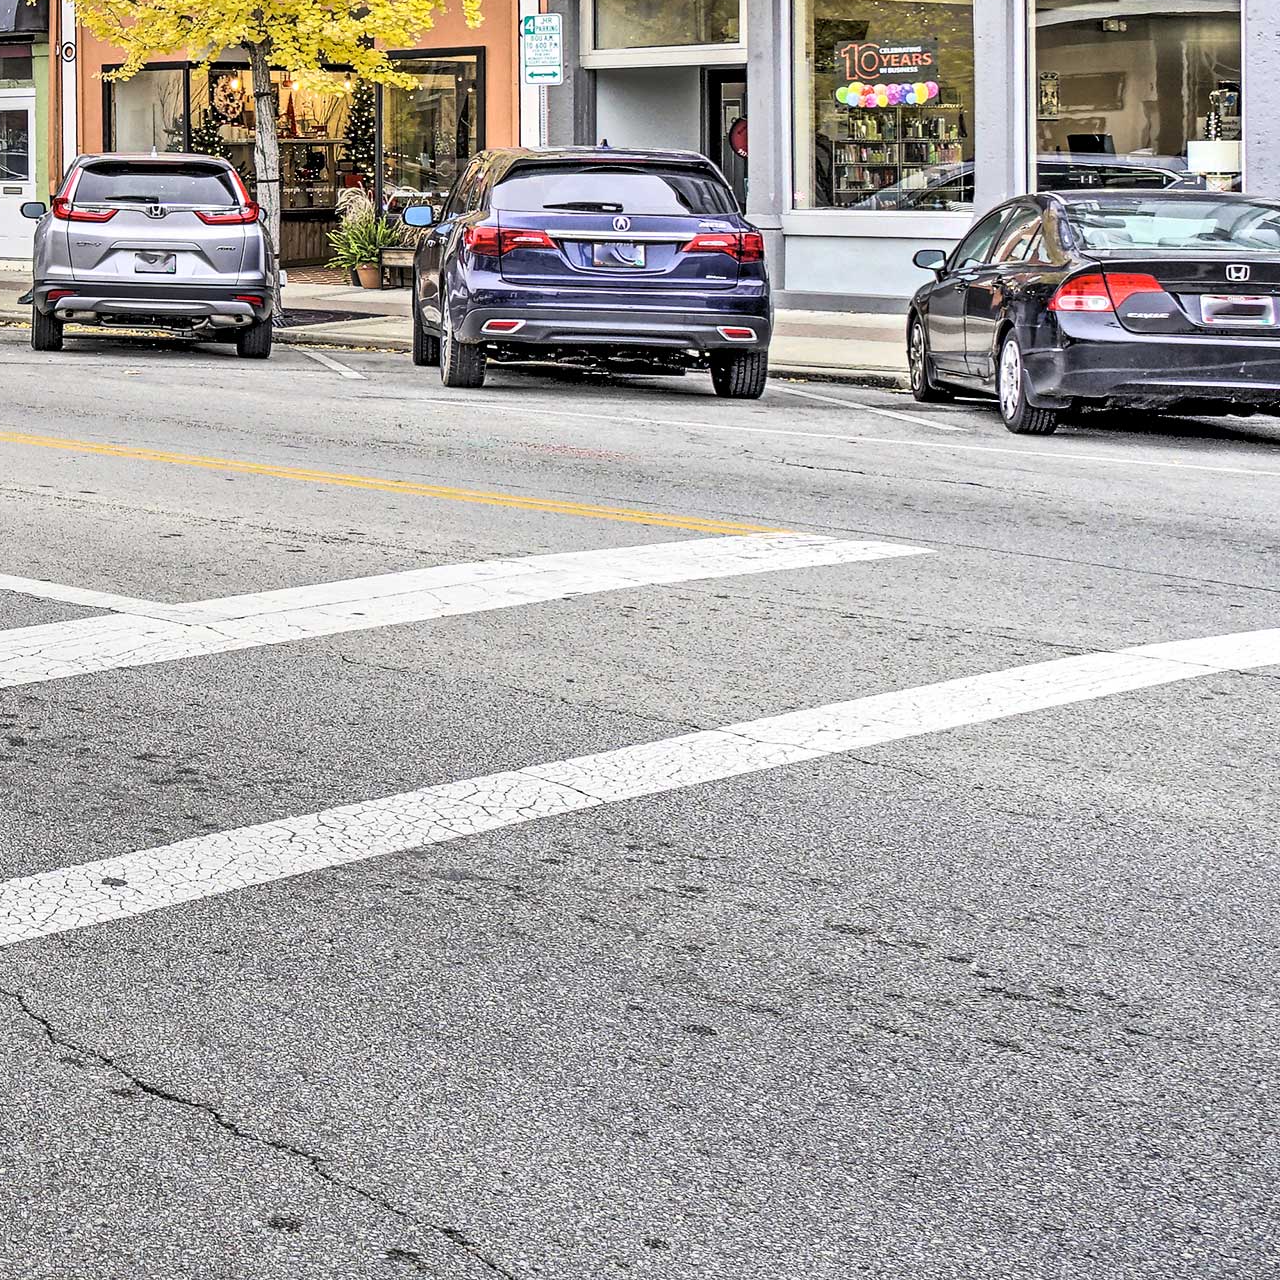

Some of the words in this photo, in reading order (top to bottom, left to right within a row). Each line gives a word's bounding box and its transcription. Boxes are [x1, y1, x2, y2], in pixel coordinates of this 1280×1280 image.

[525, 18, 535, 33] 4
[841, 43, 880, 80] 10
[880, 53, 932, 66] YEARS
